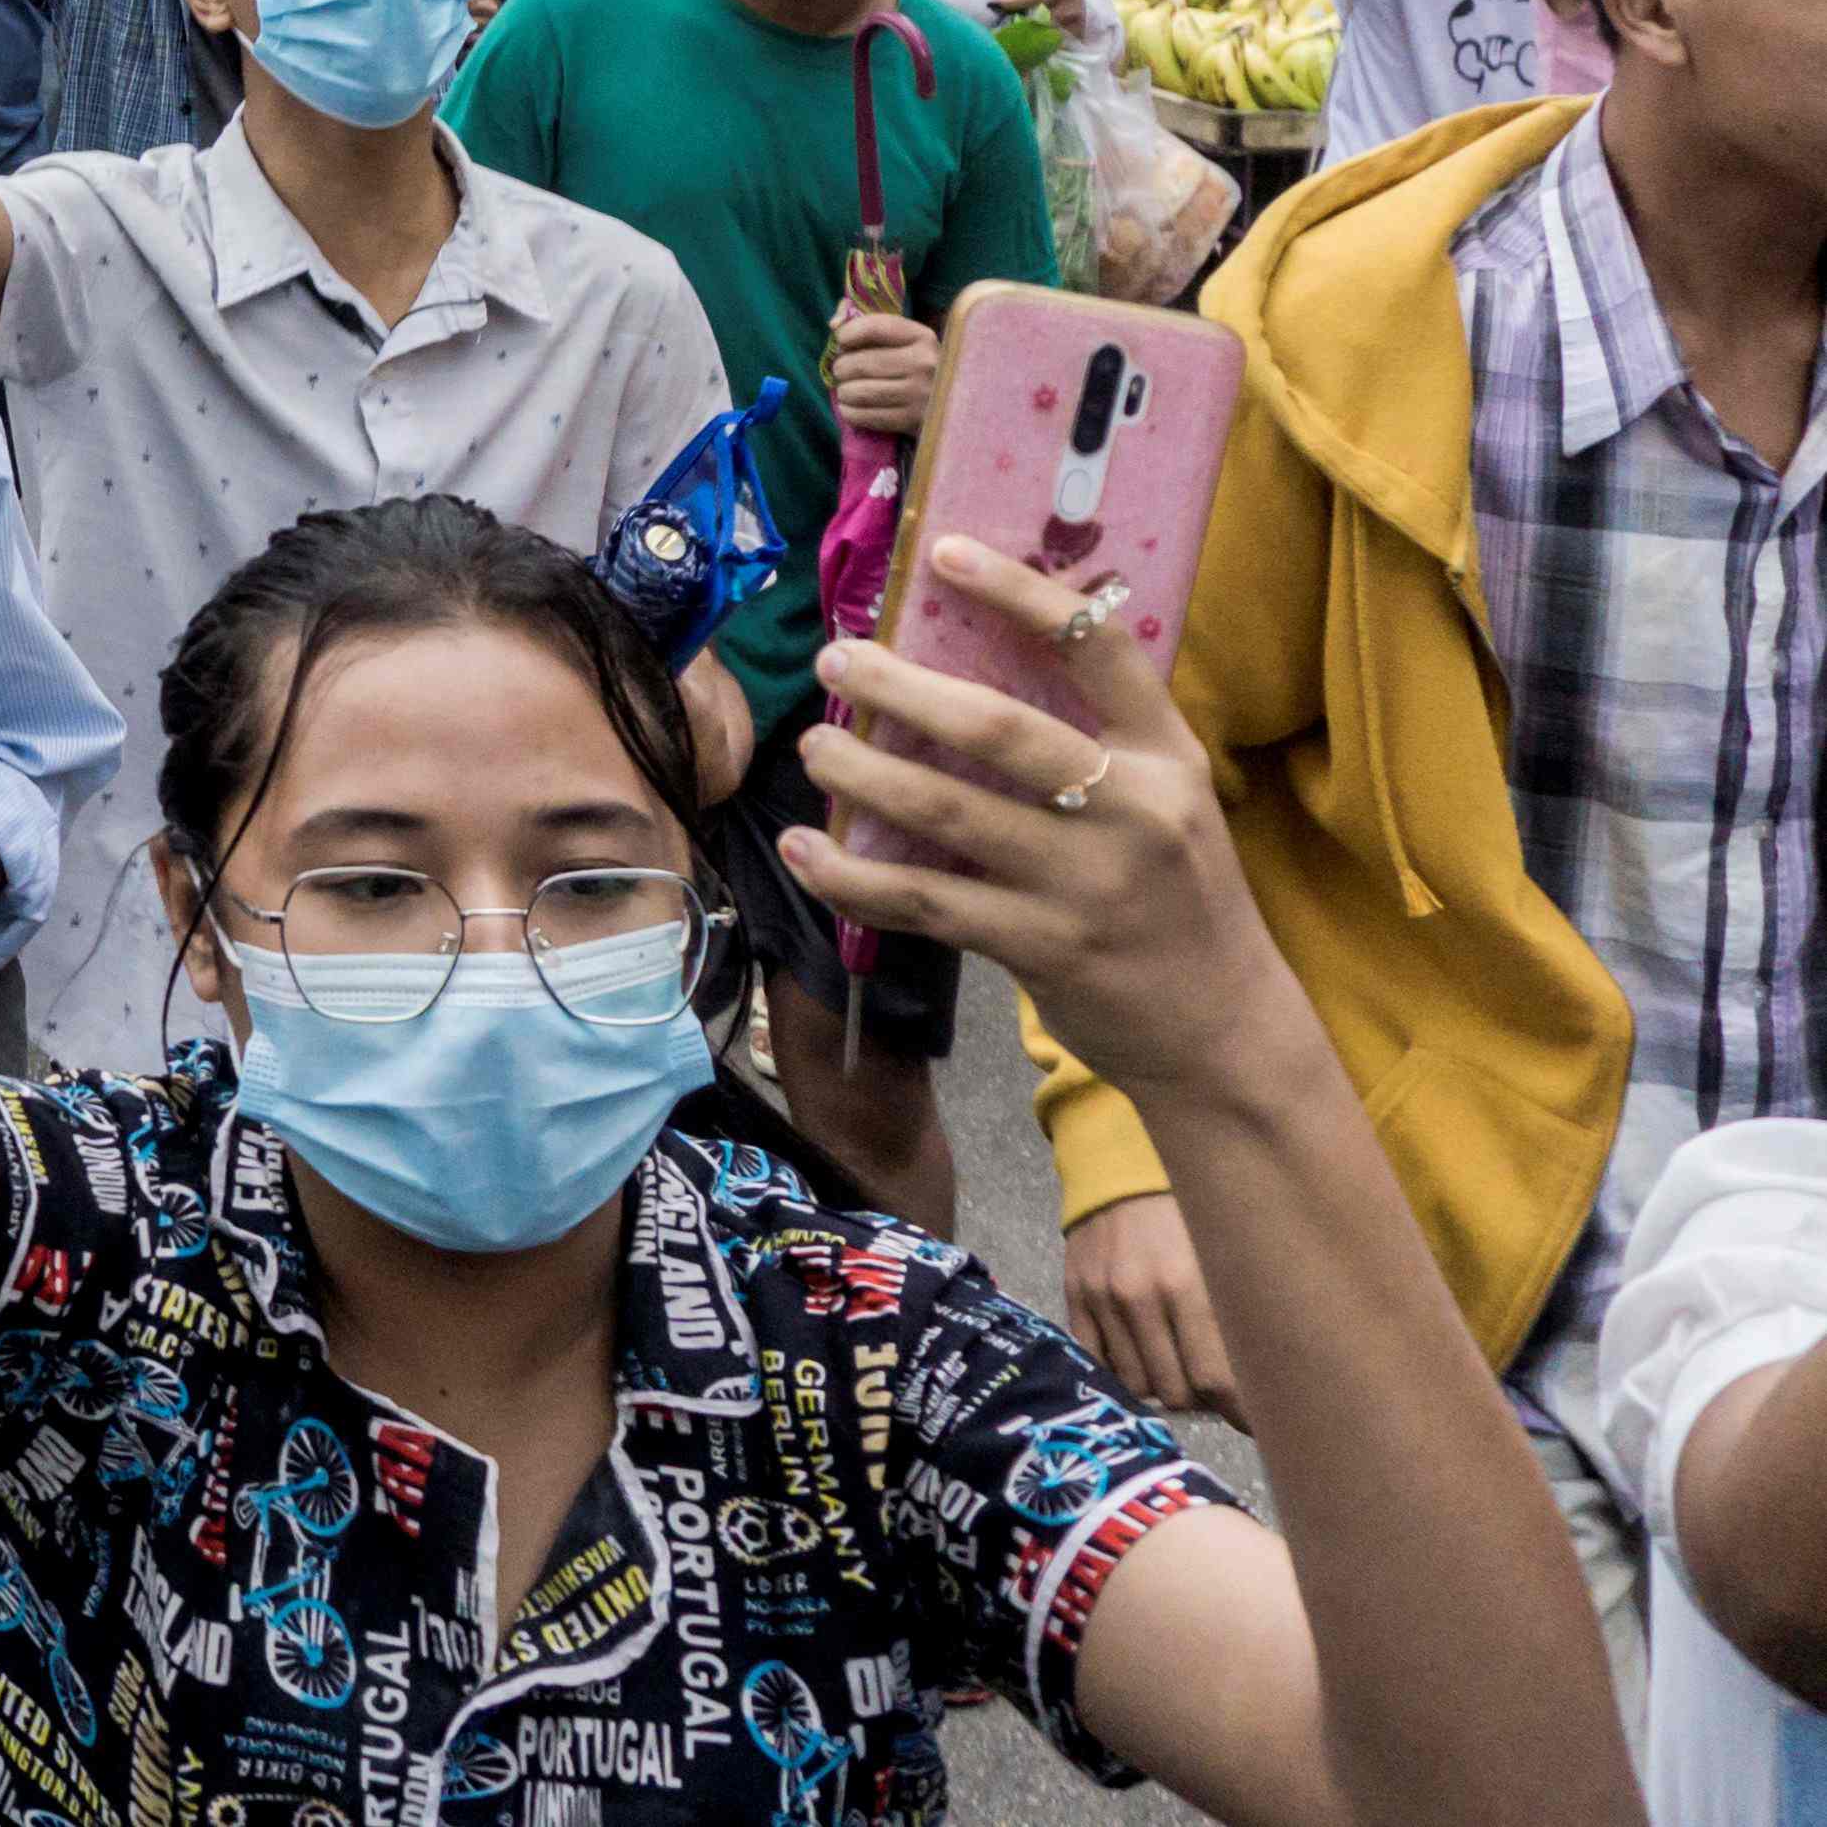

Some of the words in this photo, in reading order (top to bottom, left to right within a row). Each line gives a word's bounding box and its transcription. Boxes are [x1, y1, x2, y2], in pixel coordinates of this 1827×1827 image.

[654, 1145, 726, 1351] GLAND
[760, 1349, 812, 1497] BERLIN
[794, 1357, 879, 1592] GERMANY
[513, 1534, 626, 1622] WASHINGT
[540, 1563, 651, 1656] UNITED
[658, 1464, 733, 1760] PORTUGAL
[360, 1620, 411, 1827] RTUGAL
[518, 1714, 683, 1790] PORTUGAL
